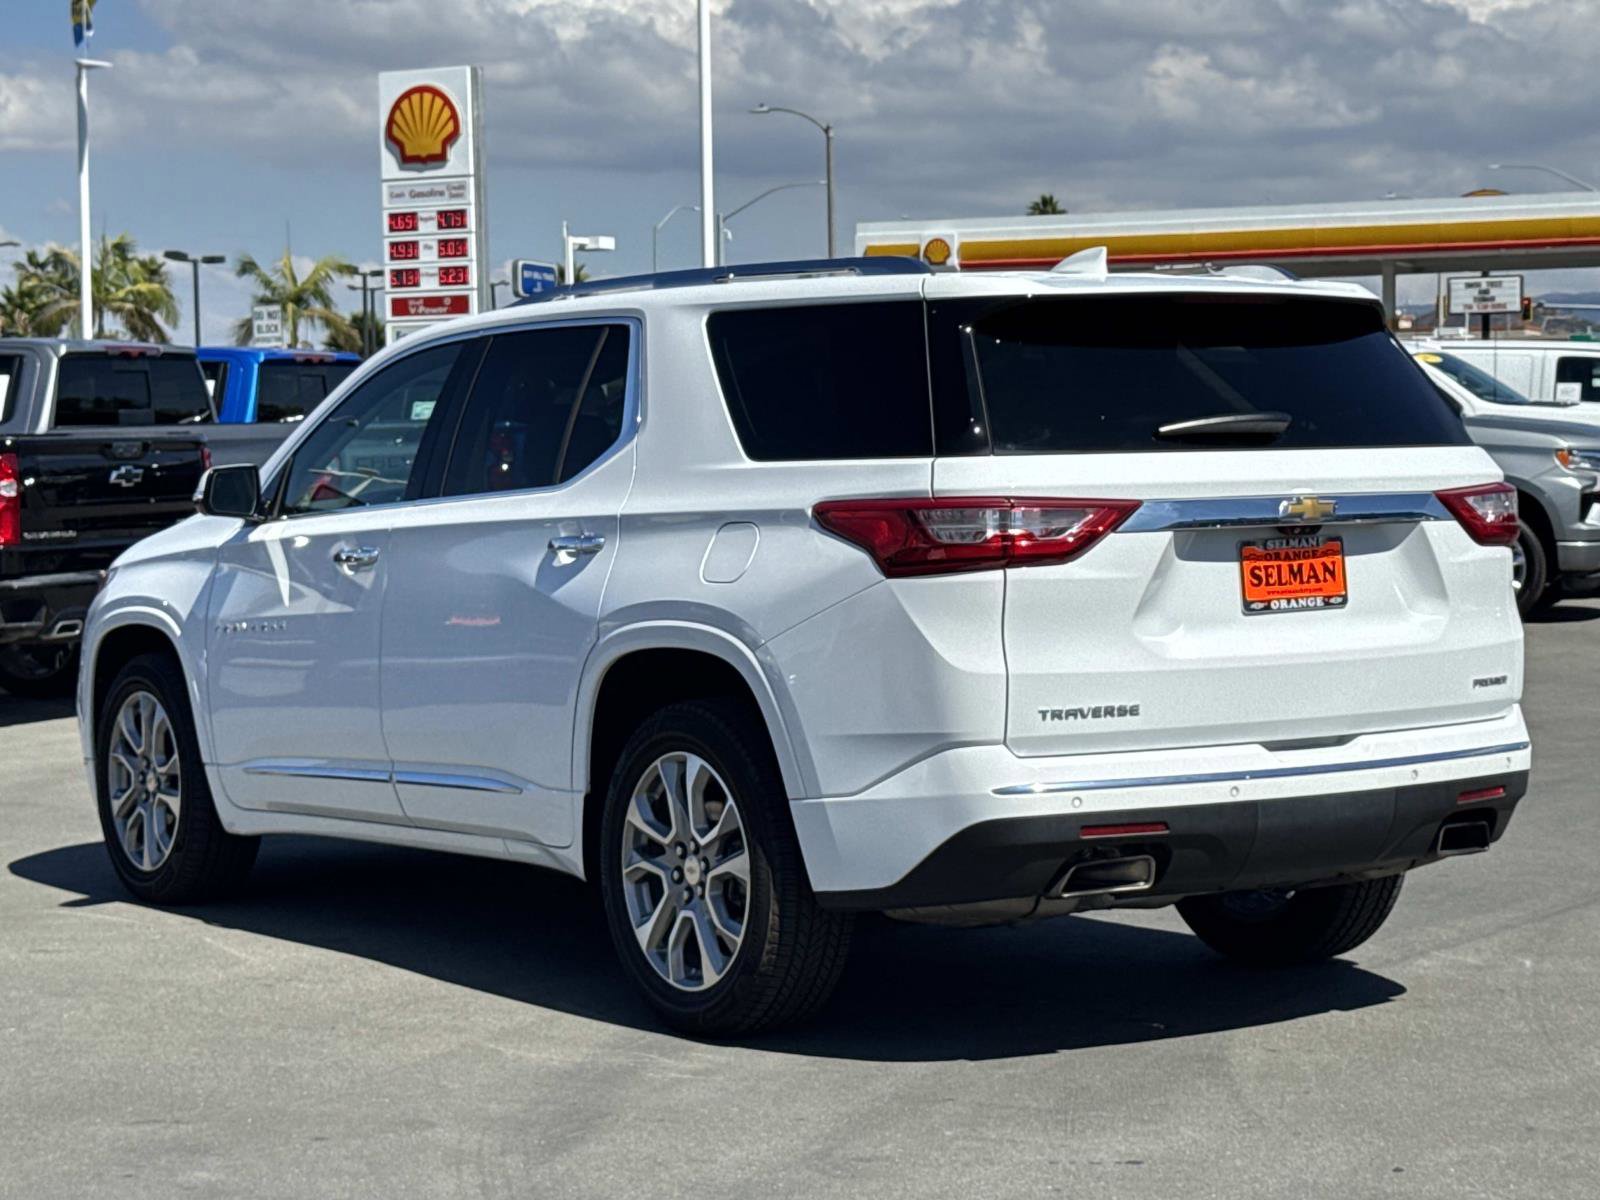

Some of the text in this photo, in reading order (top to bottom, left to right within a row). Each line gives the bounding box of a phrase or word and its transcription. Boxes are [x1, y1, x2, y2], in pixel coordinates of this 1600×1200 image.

[409, 188, 446, 199] Gasoline
[256, 323, 279, 334] BLOCK
[1266, 538, 1319, 549] SELMAN
[1263, 549, 1318, 561] ORANGE
[1249, 561, 1337, 587] SELMAN
[1270, 597, 1324, 609] ORANGE
[1038, 704, 1140, 721] TRAVERSE
